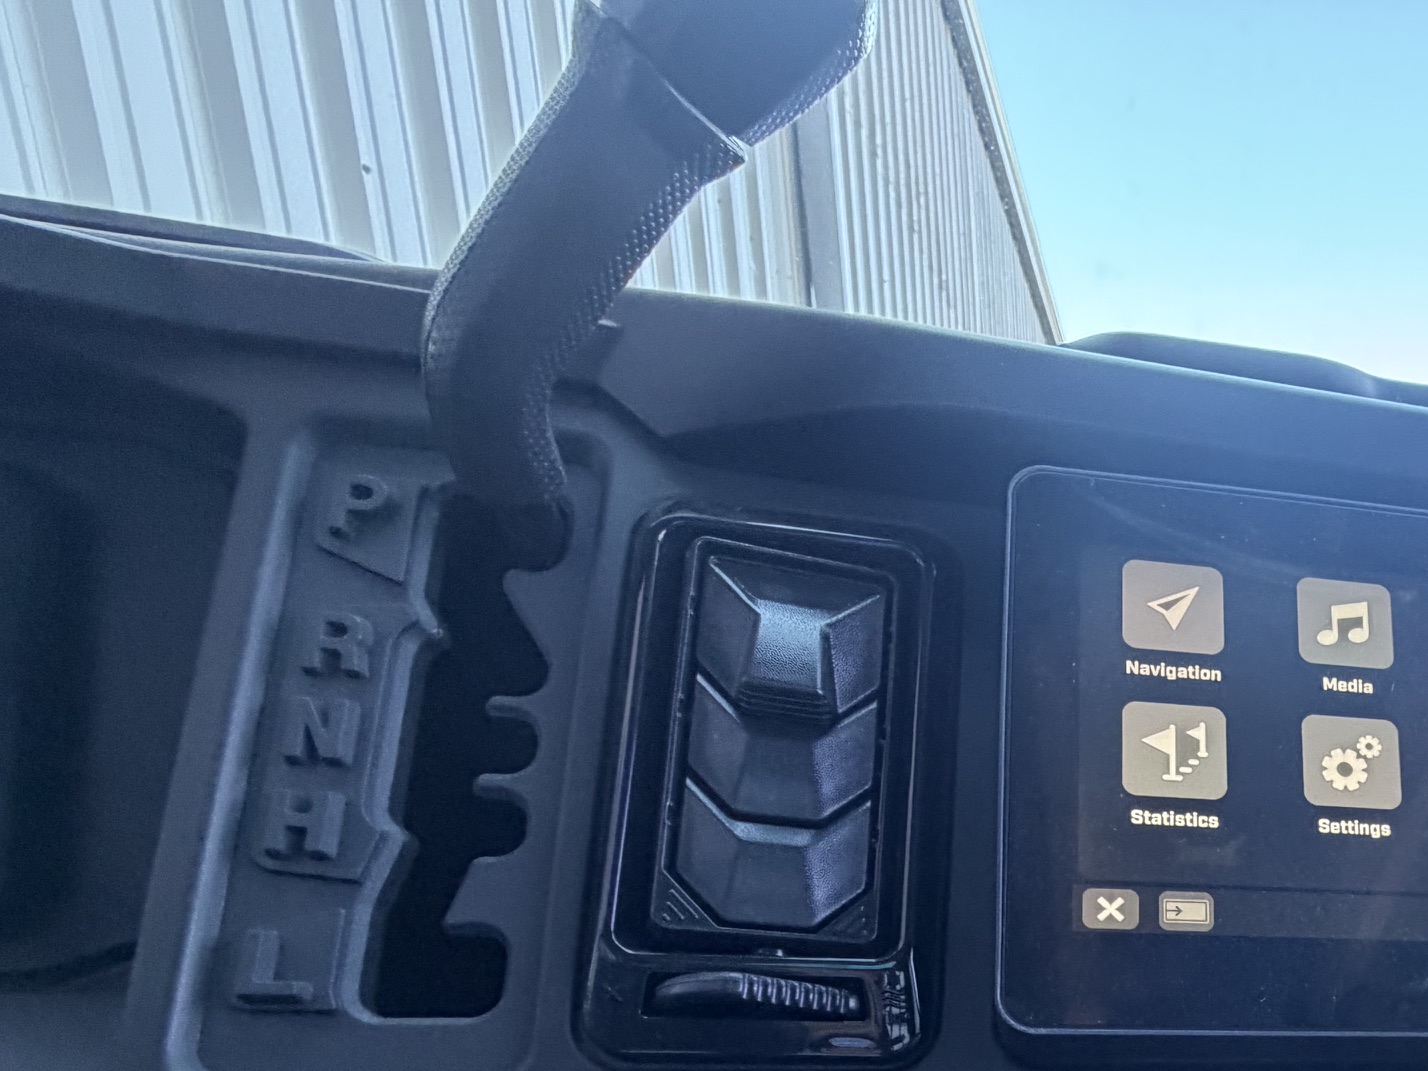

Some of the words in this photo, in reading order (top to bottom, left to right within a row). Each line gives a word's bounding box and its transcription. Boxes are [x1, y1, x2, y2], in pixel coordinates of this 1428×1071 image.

[329, 474, 387, 540] P
[301, 612, 373, 679] R
[1125, 660, 1222, 682] Navigation
[1322, 677, 1373, 695] Media
[284, 697, 360, 766] N
[264, 791, 345, 861] H
[1130, 809, 1219, 829] Statistics
[1318, 818, 1391, 839] Settings
[234, 929, 314, 1003] L
